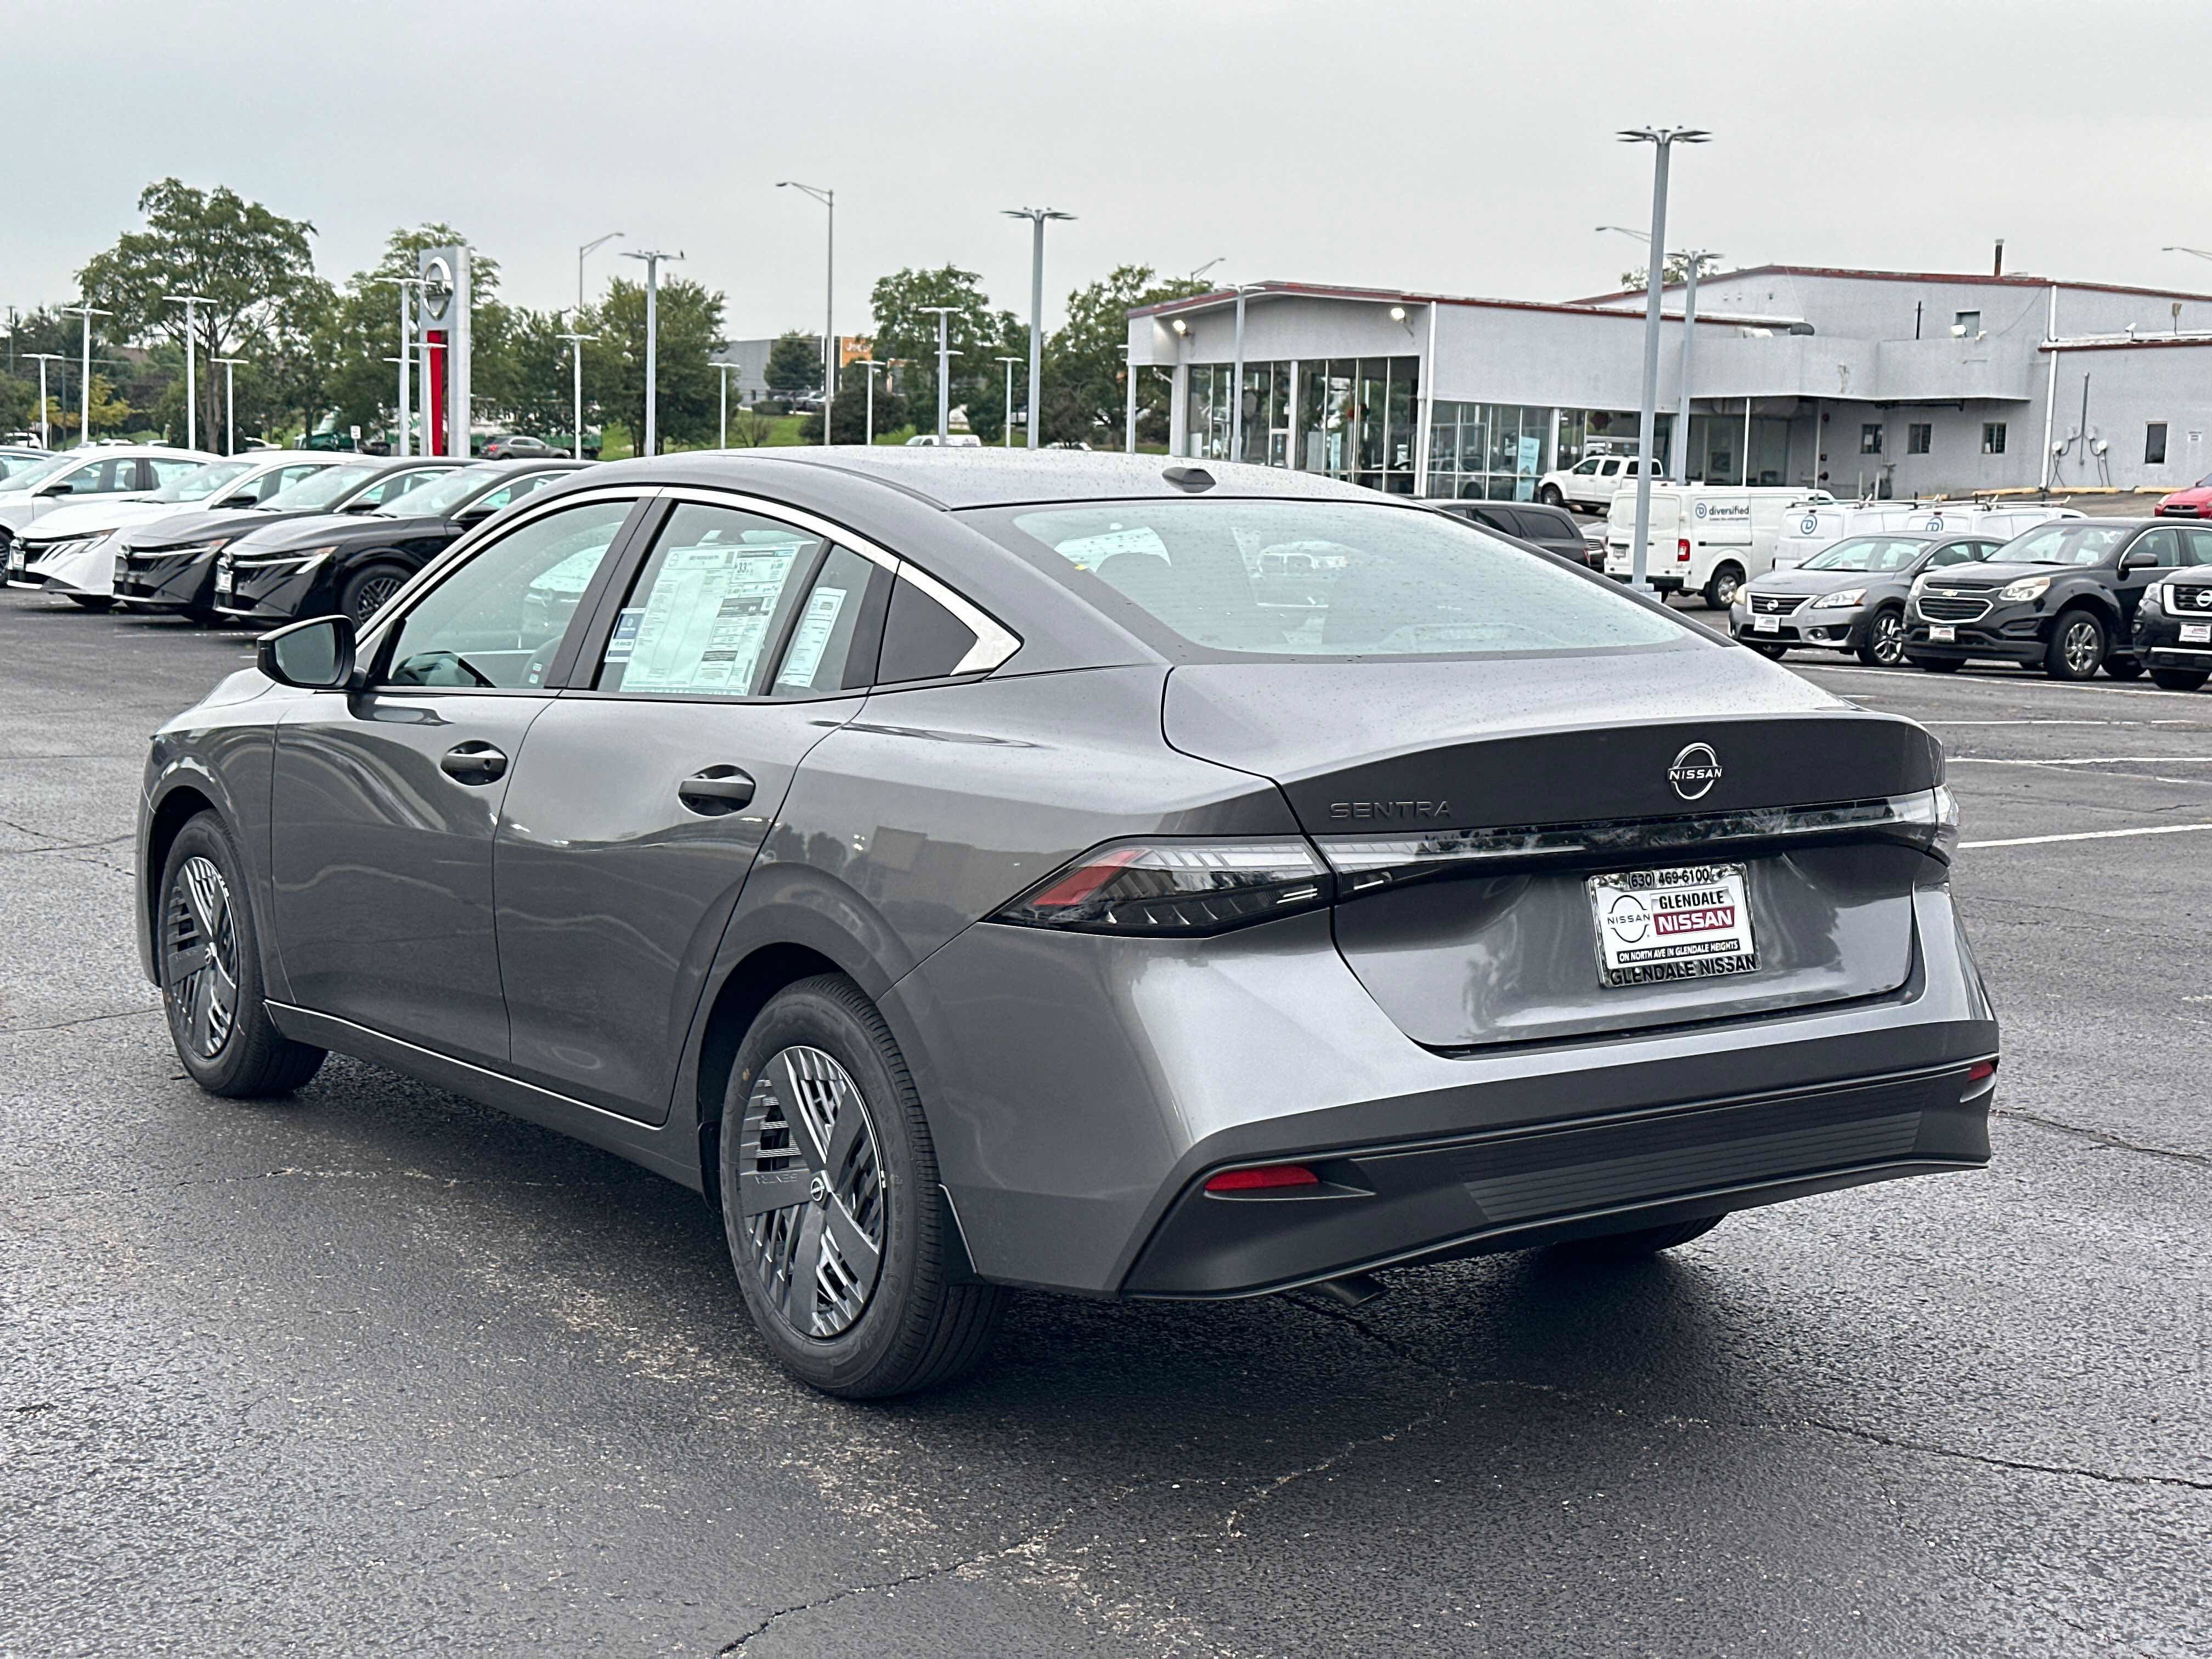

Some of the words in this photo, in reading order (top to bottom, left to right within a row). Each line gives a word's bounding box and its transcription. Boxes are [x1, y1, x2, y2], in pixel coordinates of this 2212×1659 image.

[1709, 505, 1749, 515] diversified
[1669, 769, 1722, 780] NISSAN
[1330, 801, 1451, 818] SENTRA
[1628, 871, 1655, 889] (630)
[1658, 868, 1709, 886] 469-6100
[1659, 890, 1725, 909] GLENDALE
[1607, 913, 1650, 924] NISSAN
[1658, 910, 1733, 932] NISSAN
[1619, 952, 1629, 962] ON
[1630, 950, 1652, 961] NORTH
[1654, 949, 1666, 958] AVE
[1667, 948, 1674, 956] IN
[1675, 943, 1709, 956] GLENDALE
[1711, 940, 1739, 952] HEIGHTS
[1610, 961, 1696, 985] GLENDALE
[1701, 955, 1756, 975] NISSAN
